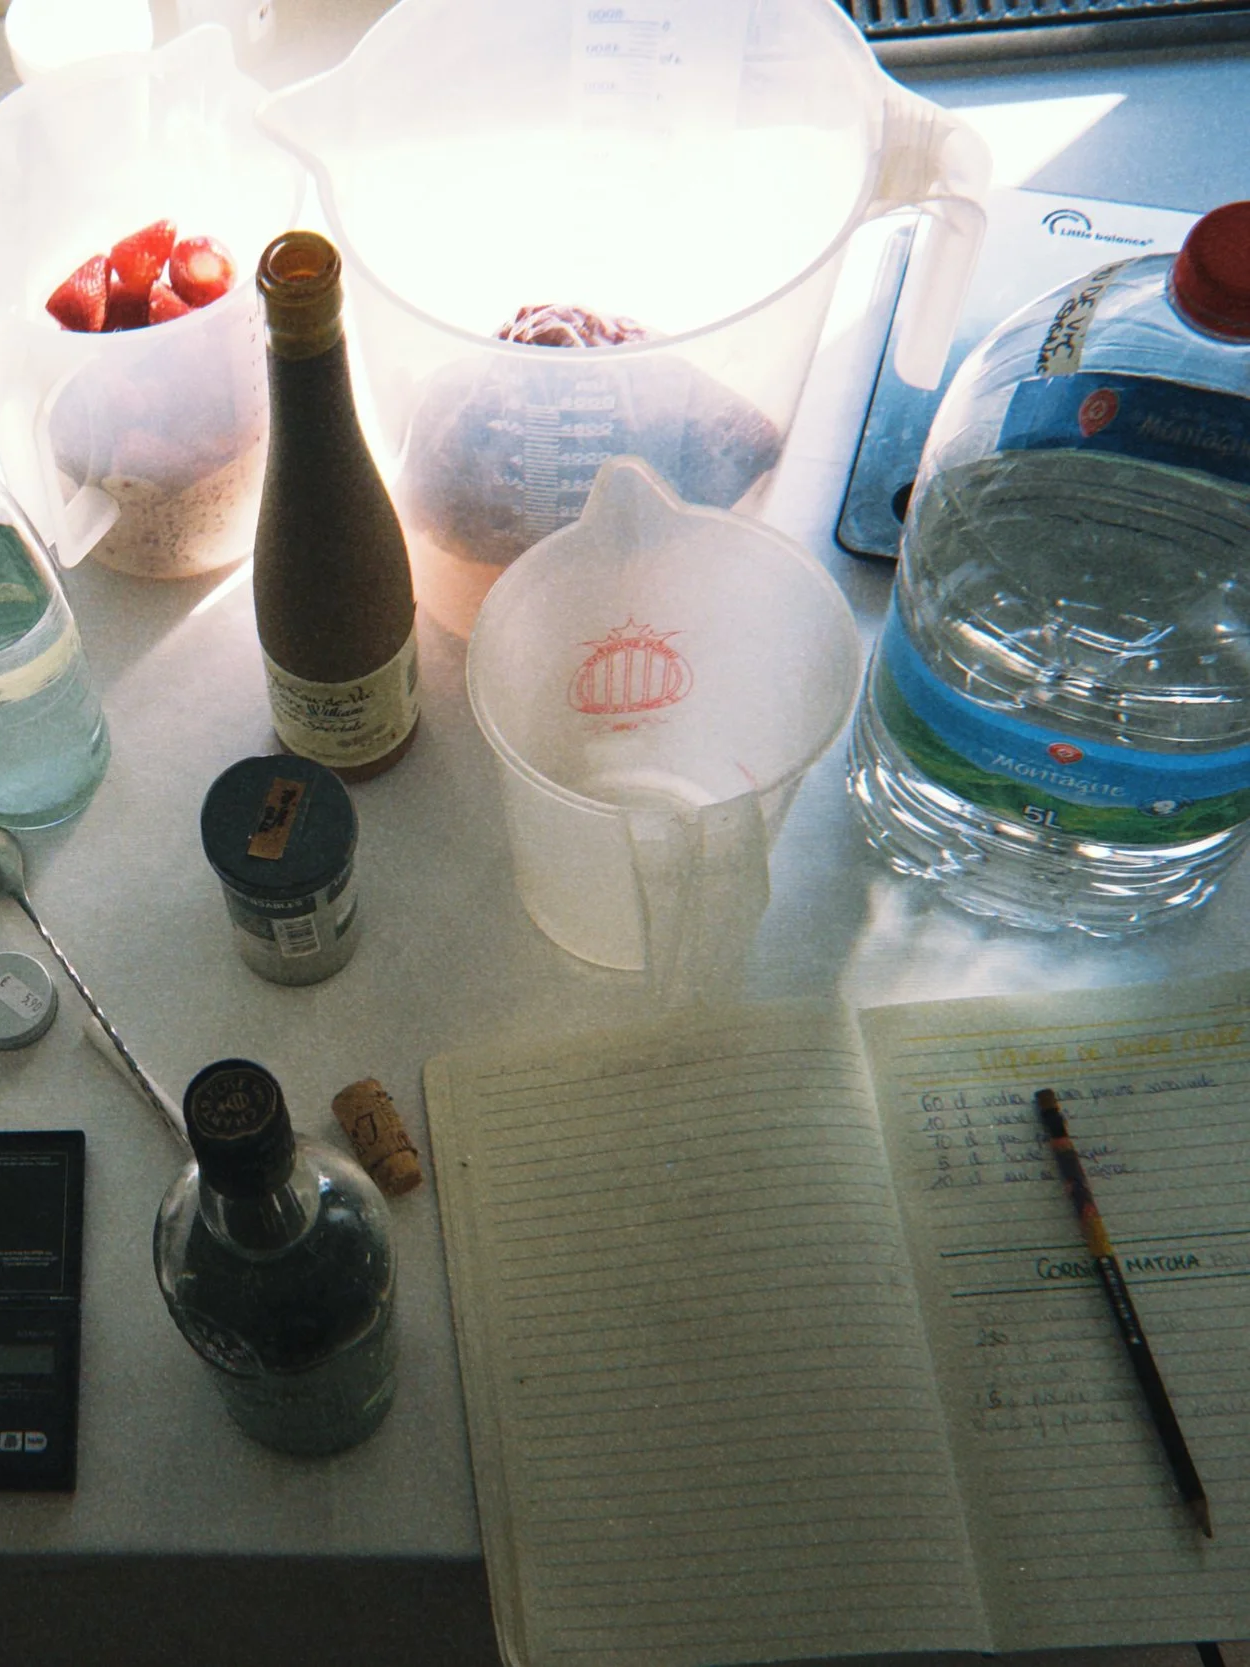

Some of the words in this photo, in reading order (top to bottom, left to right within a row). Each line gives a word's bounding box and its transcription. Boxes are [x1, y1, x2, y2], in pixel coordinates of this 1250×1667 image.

[1059, 226, 1092, 240] Little
[993, 753, 1128, 798] Montagne
[1021, 804, 1063, 831] 5L
[921, 1092, 945, 1112] 60
[1126, 1253, 1201, 1272] MATCHA
